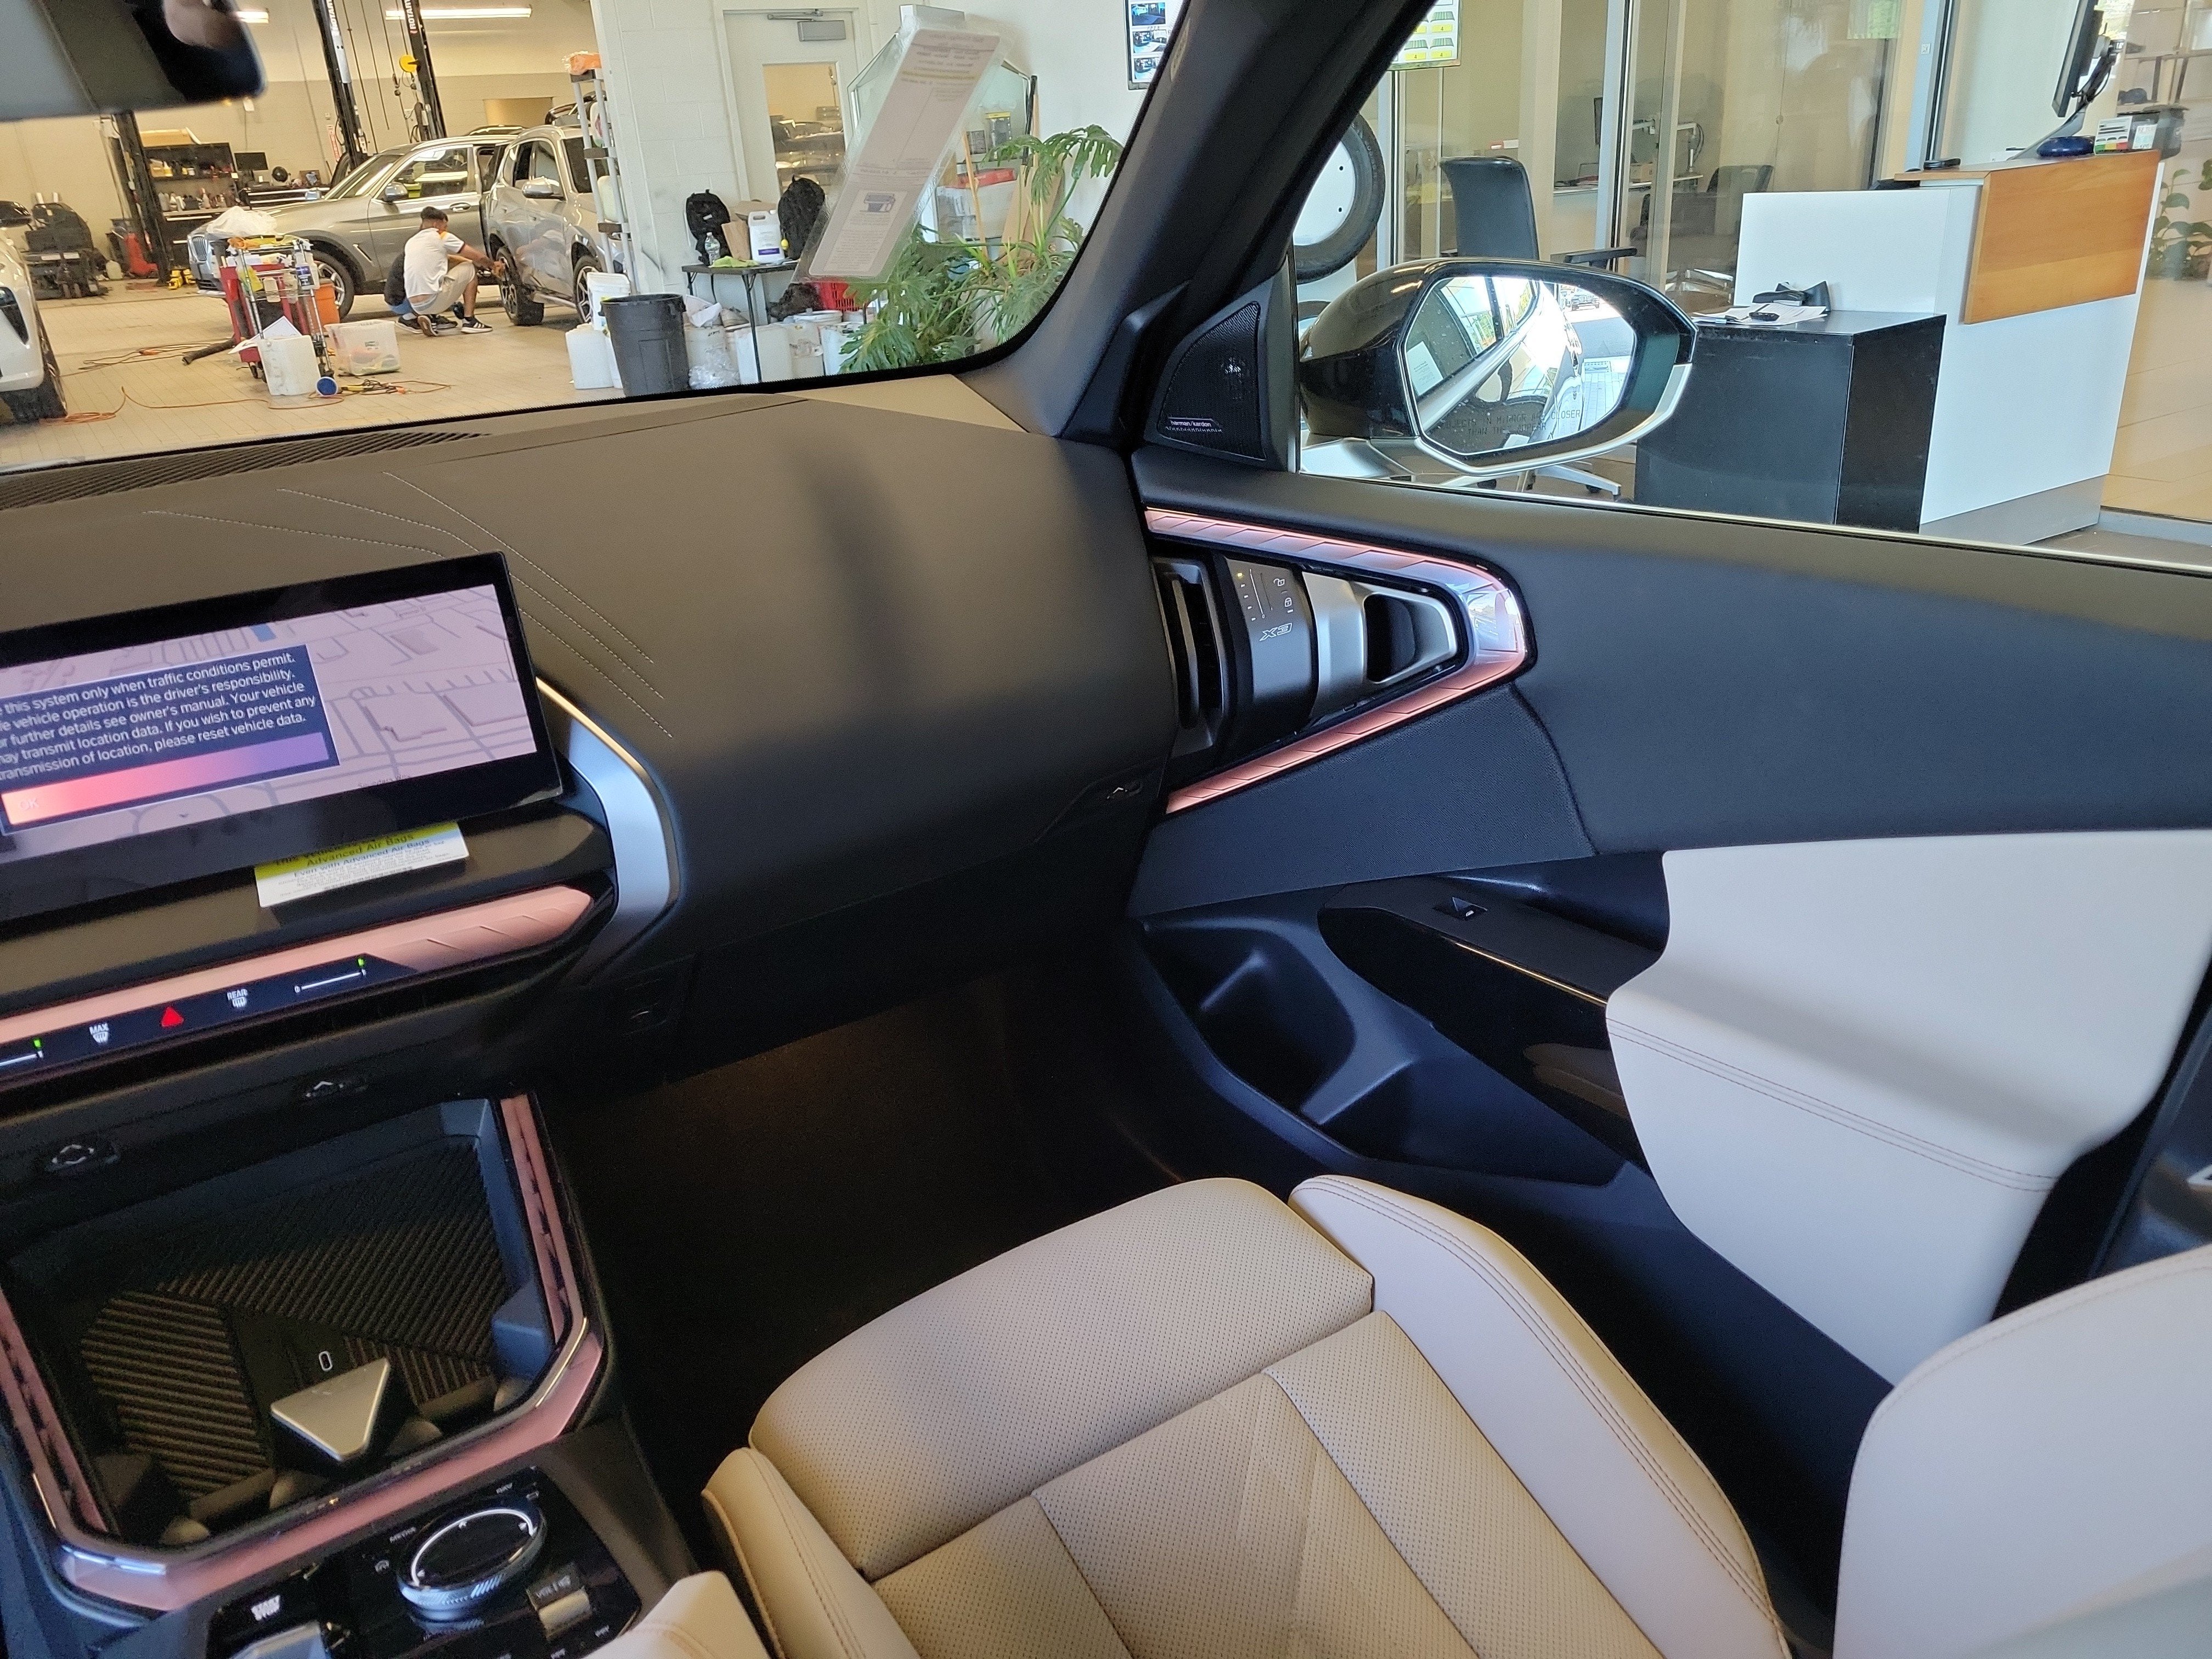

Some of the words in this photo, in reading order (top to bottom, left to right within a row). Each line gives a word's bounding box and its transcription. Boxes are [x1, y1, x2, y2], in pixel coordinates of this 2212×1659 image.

[1551, 409, 1580, 420] CLOSER
[1260, 622, 1293, 641] X3
[4, 702, 31, 714] this
[32, 692, 80, 710] system
[81, 686, 109, 699] only
[111, 681, 146, 695] when
[148, 673, 184, 687] traffic
[187, 662, 251, 681] conditions
[252, 652, 296, 671] permit.
[13, 712, 60, 729] vehicle
[63, 700, 125, 720] operation
[126, 697, 138, 708] is
[140, 693, 161, 706] the
[165, 684, 210, 701] driver's
[212, 669, 295, 692] responsibility.
[10, 730, 55, 745] further
[58, 720, 102, 737] details
[104, 716, 127, 729] see
[129, 706, 178, 723] owner's
[180, 696, 230, 714] manual.
[230, 691, 261, 704] Your
[261, 682, 305, 698] vehicle
[21, 740, 76, 760] transmit
[77, 731, 129, 749] location
[132, 725, 163, 739] data.
[165, 720, 173, 732] If
[176, 718, 199, 732] you
[201, 709, 229, 725] wish
[230, 709, 244, 719] to
[247, 698, 294, 719] prevent
[295, 695, 315, 708] any
[82, 751, 95, 764] of
[97, 743, 153, 761] location,
[154, 734, 196, 753] please
[198, 726, 230, 742] reset
[231, 719, 274, 735] vehicle
[276, 713, 307, 727] data.
[20, 798, 39, 810] OK
[307, 845, 362, 867] Advanced
[367, 841, 382, 851] Air
[386, 834, 414, 847] Bags
[320, 862, 340, 871] with
[343, 849, 388, 866] Advanced
[392, 845, 404, 853] Air
[407, 839, 430, 849] Bags
[227, 989, 248, 1001] REAR
[89, 1023, 109, 1035] MAX
